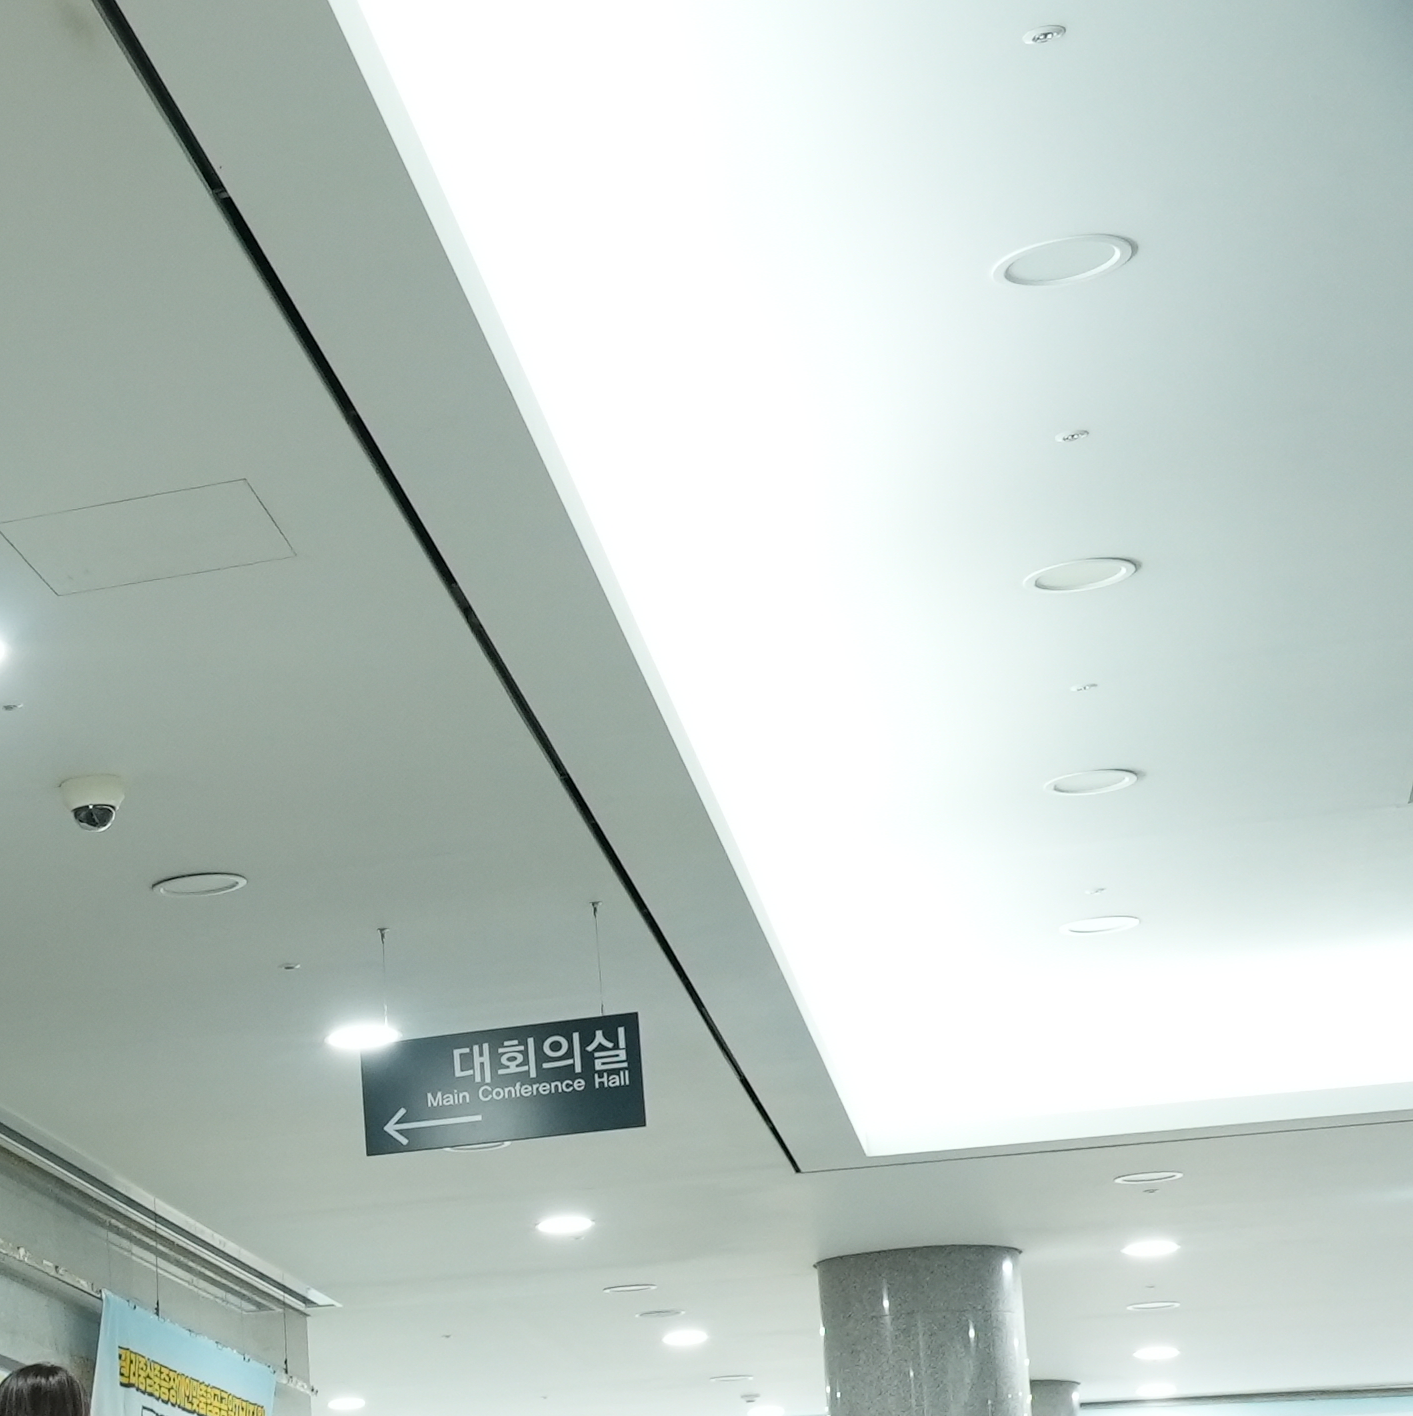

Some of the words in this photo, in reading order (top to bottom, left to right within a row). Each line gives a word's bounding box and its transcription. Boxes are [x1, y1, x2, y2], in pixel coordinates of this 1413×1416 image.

[452, 1026, 629, 1083] 대회의실
[426, 1090, 470, 1108] Main
[478, 1078, 586, 1102] Conference
[594, 1070, 630, 1090] Hall
